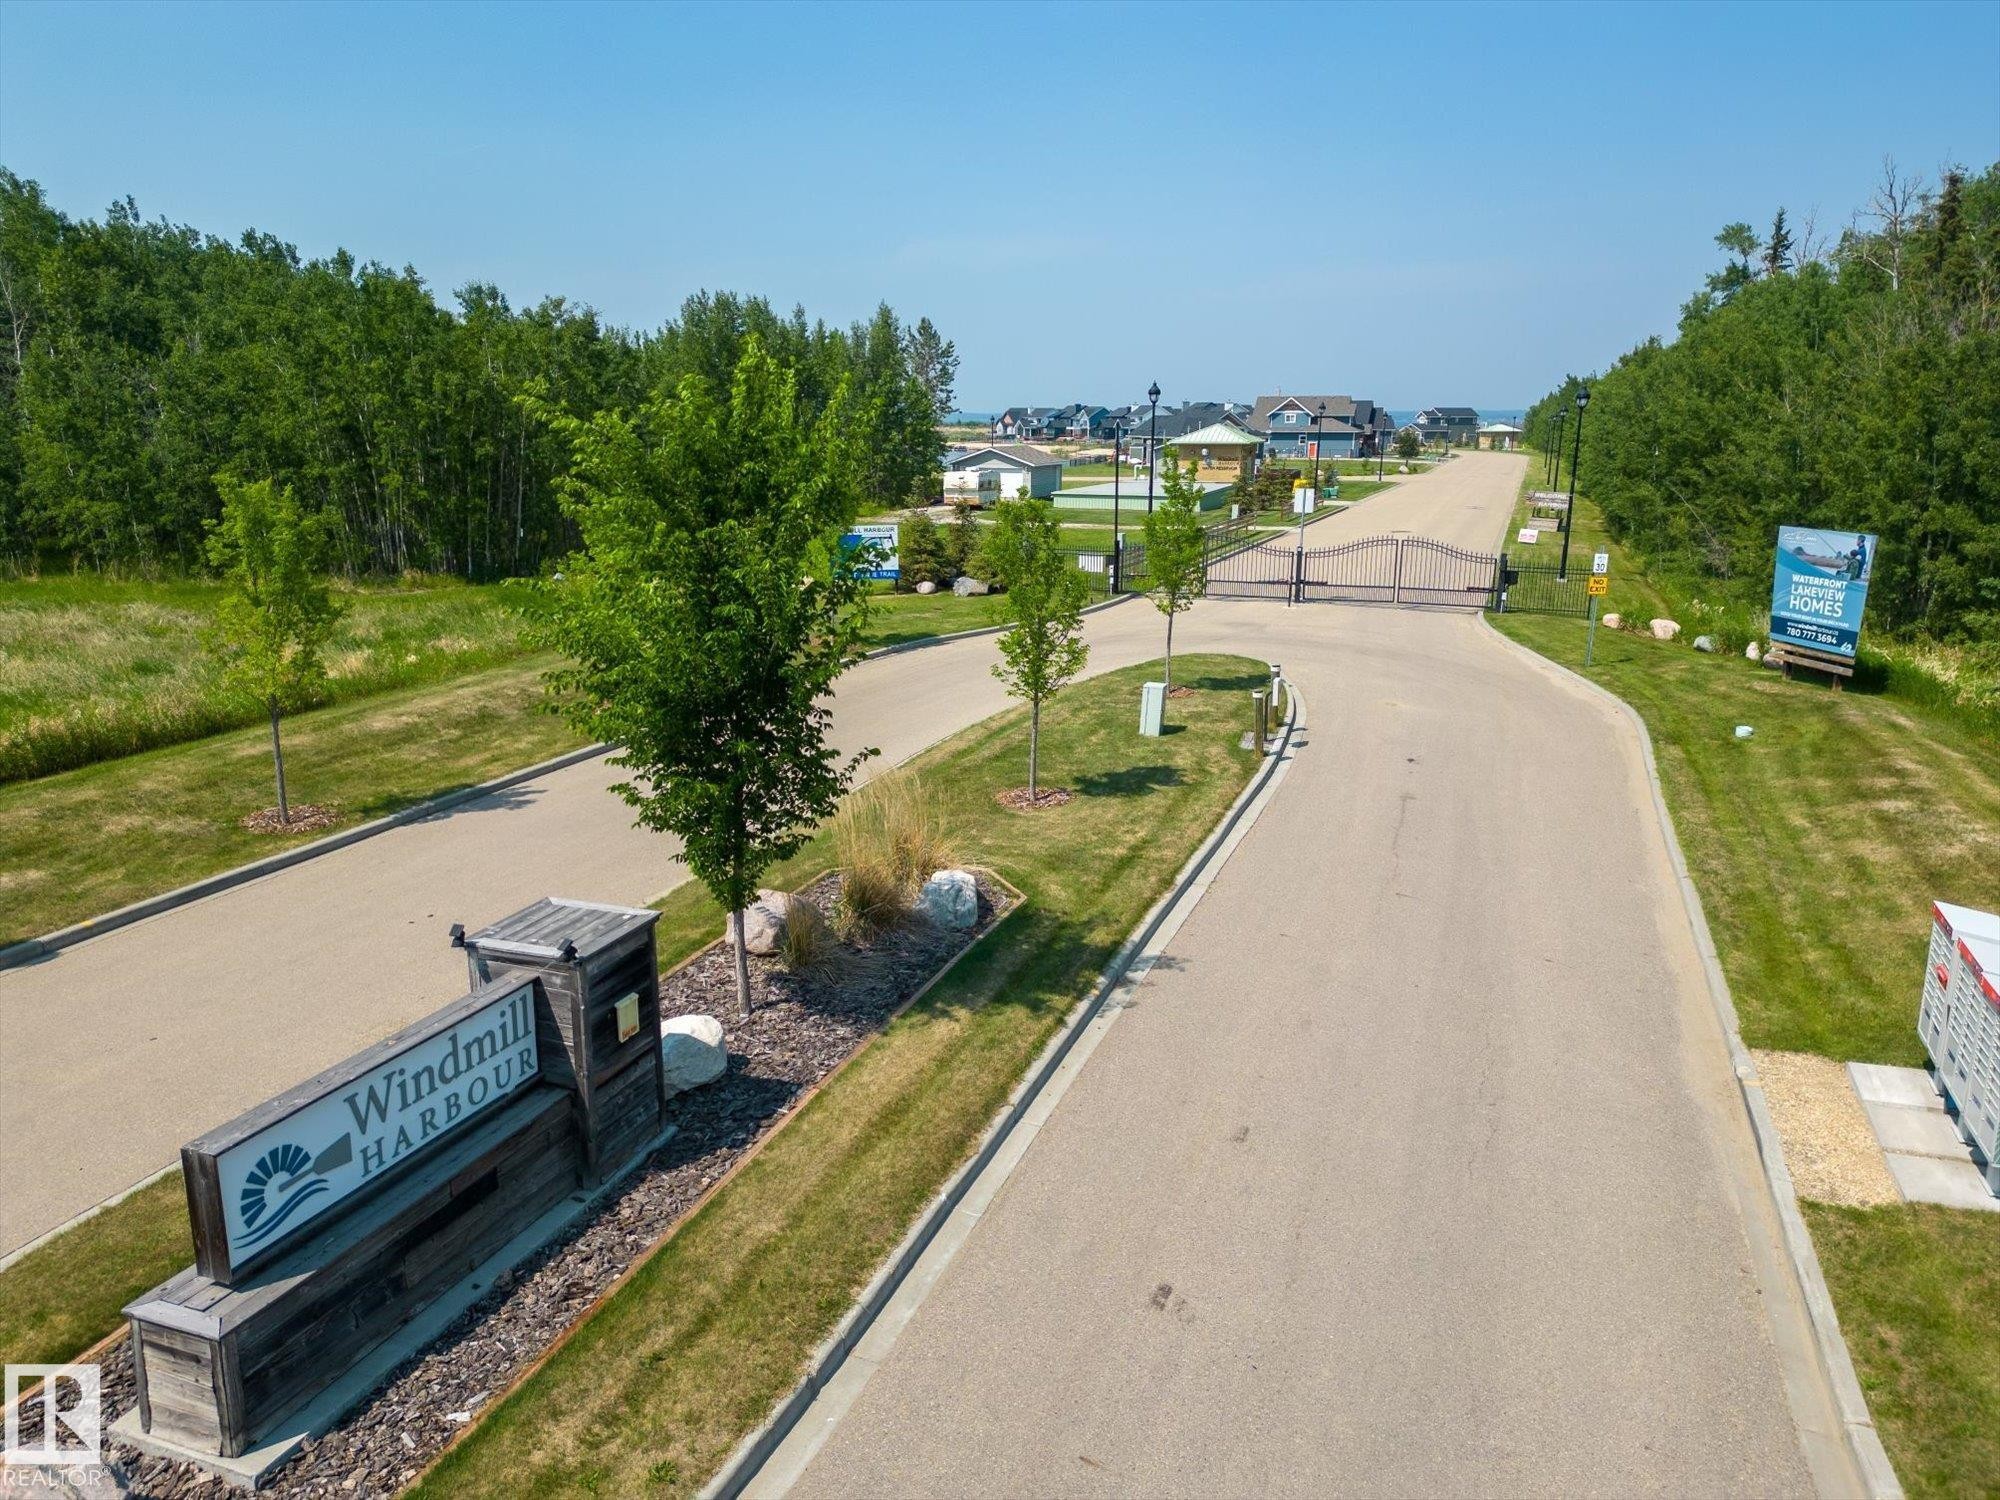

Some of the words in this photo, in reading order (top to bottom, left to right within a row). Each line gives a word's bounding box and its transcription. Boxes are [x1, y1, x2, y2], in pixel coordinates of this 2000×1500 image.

[1595, 563, 1605, 572] 30
[1593, 578, 1605, 586] NO
[1792, 574, 1848, 589] WATERFRONT
[1791, 584, 1846, 601] LAKEVIEW
[1789, 595, 1843, 617] HOMES
[1786, 627, 1801, 637] 780
[1802, 630, 1816, 640] 777
[1816, 633, 1838, 644] 3694
[343, 994, 532, 1136] Windmill
[359, 1047, 536, 1178] HARBOUR
